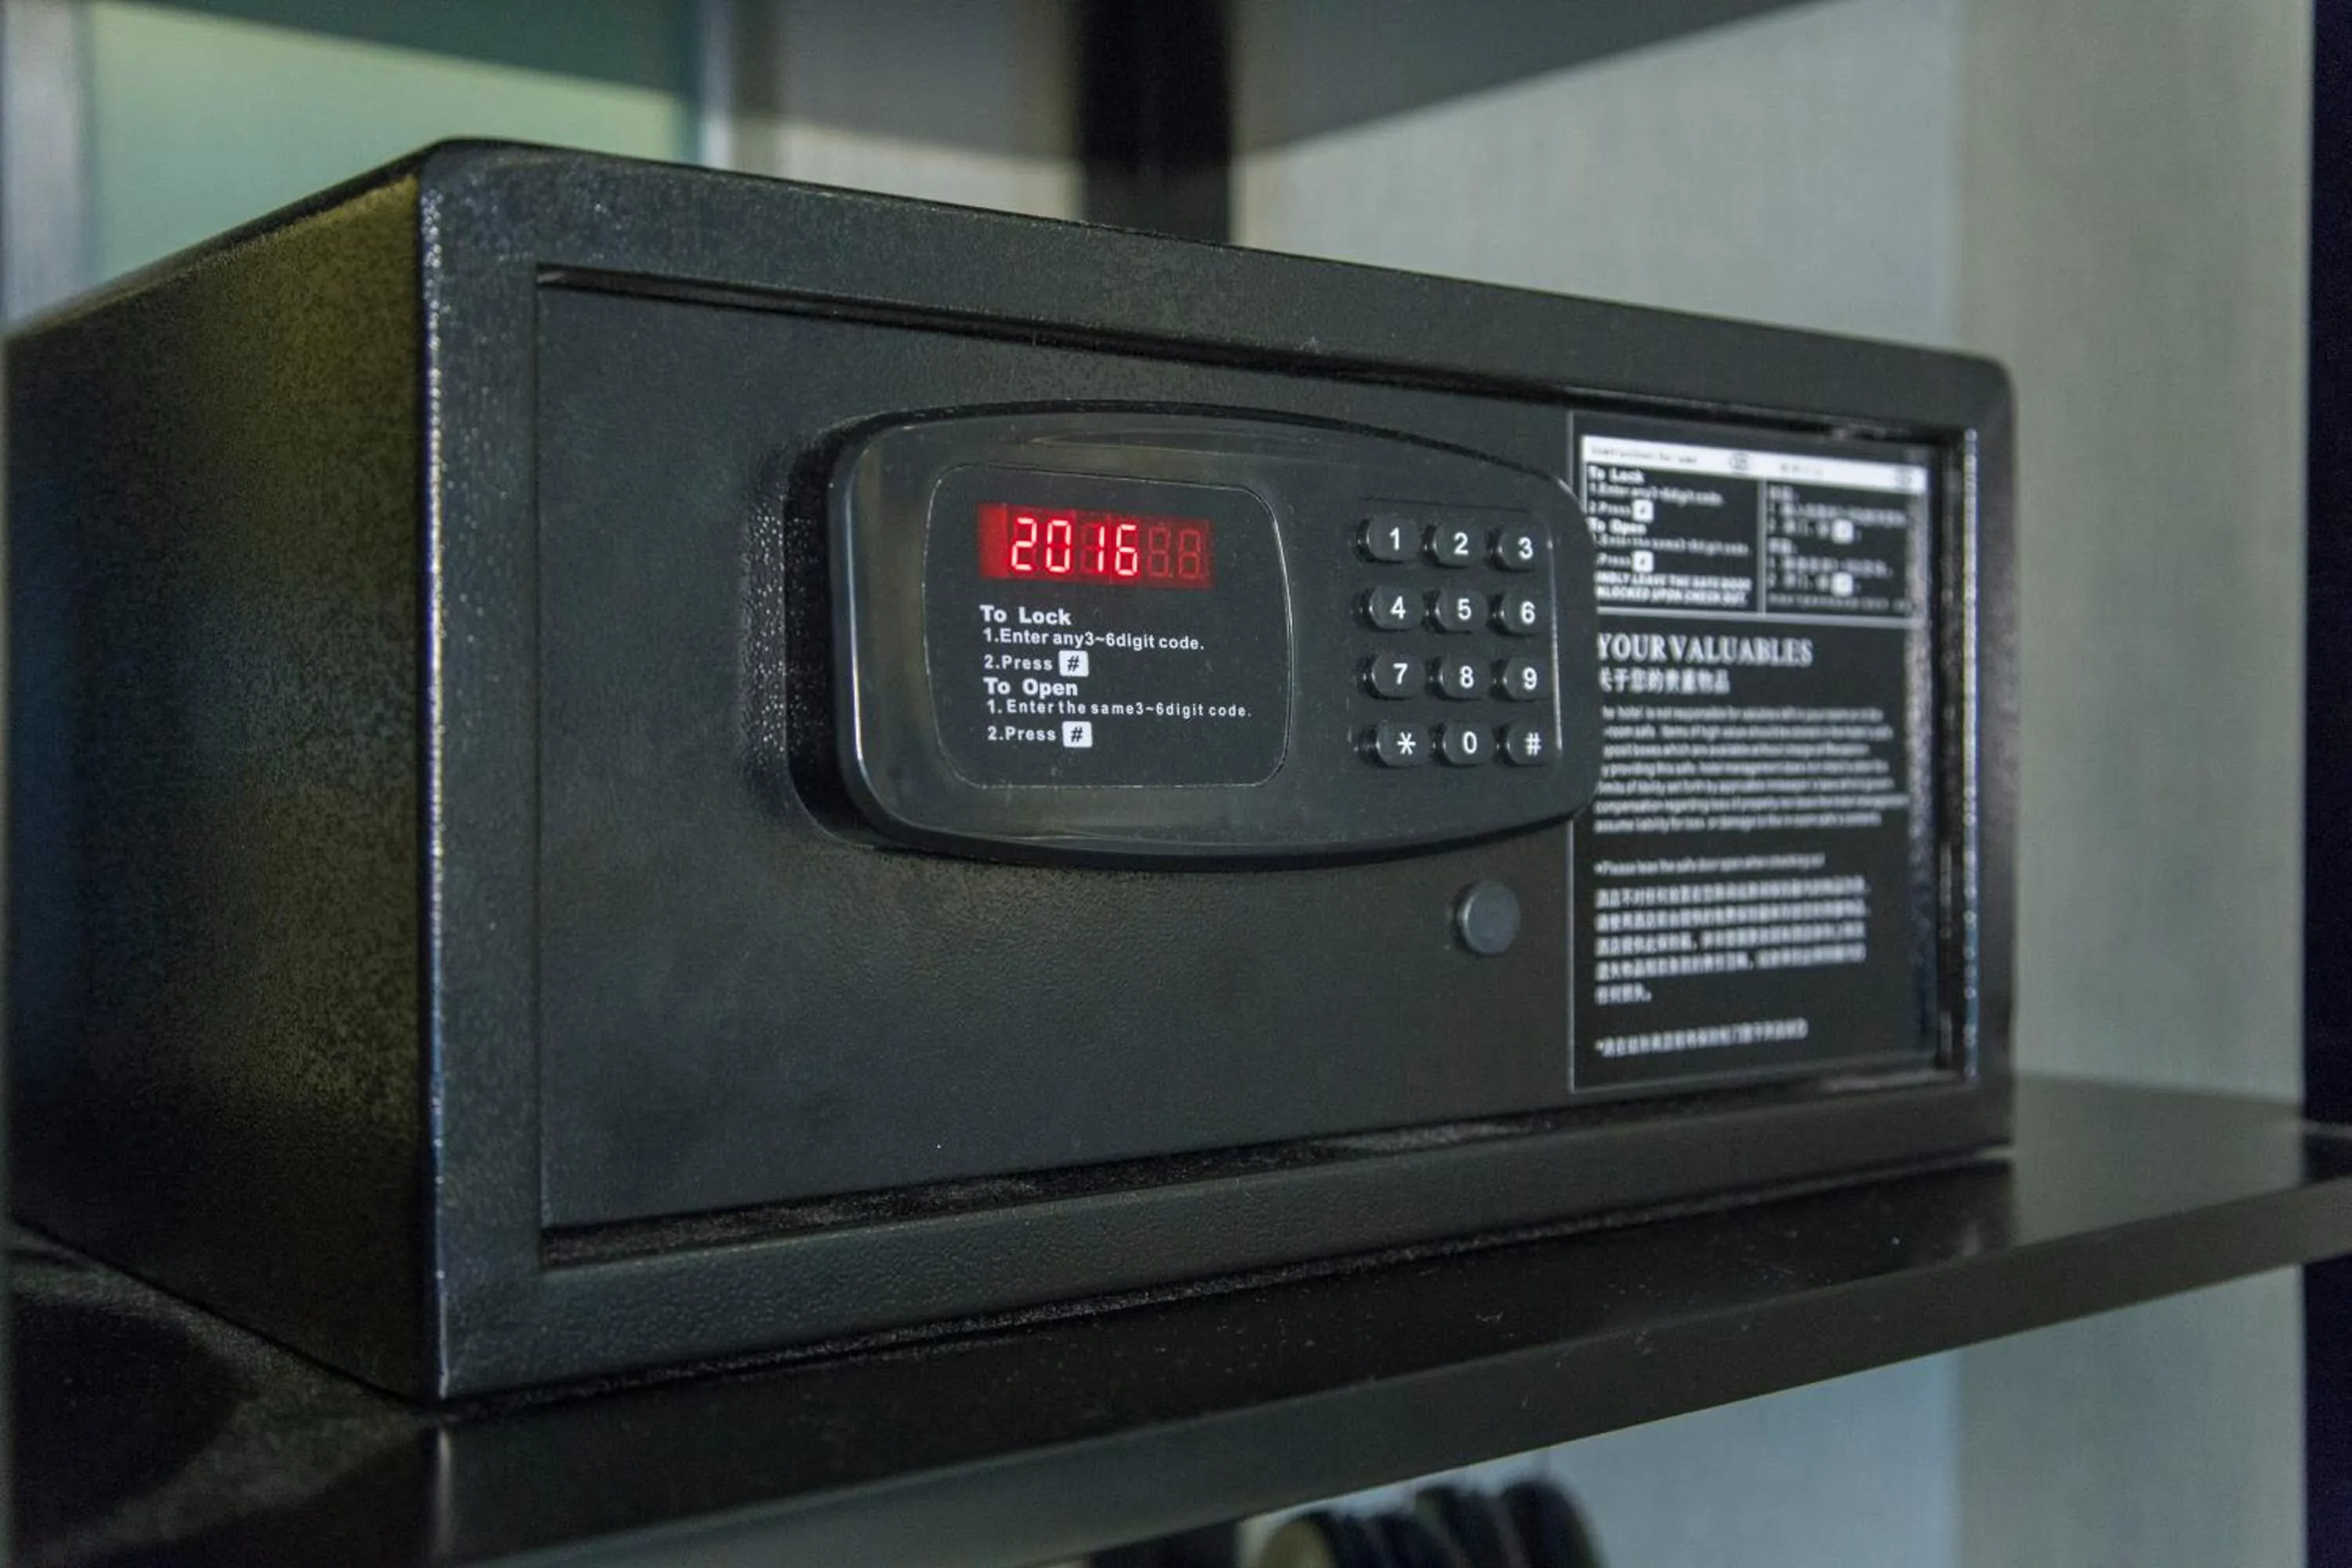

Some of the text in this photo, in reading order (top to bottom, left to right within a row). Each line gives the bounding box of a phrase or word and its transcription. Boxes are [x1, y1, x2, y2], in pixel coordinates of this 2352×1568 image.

[1011, 517, 1138, 575] 2016
[1389, 527, 1534, 559] 1 2 3
[979, 604, 1072, 626] To Lock
[1390, 596, 1535, 624] 4 5 6
[1158, 636, 1205, 650] code.
[1596, 632, 1813, 666] YOUR VALUABLES
[984, 654, 1053, 670] 2.Press
[982, 677, 1078, 699] To Open
[1394, 663, 1537, 690] 7 8 9
[1208, 703, 1253, 717] code.
[987, 726, 1057, 741] 2.Press
[1462, 731, 1477, 753] 0
[1525, 732, 1541, 755] #
